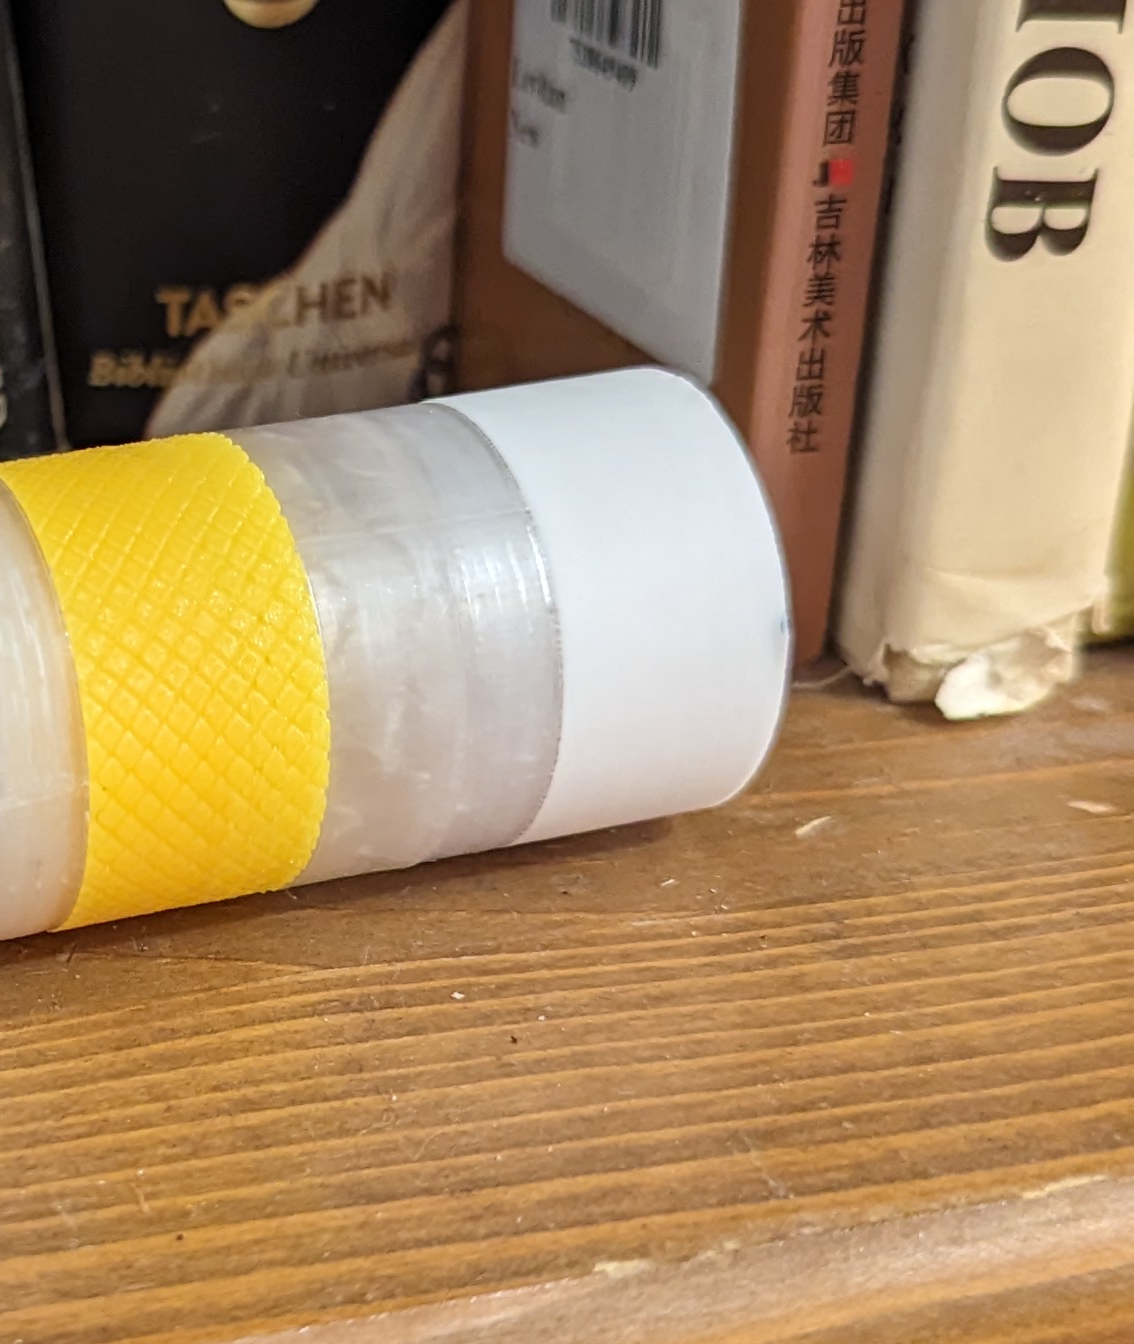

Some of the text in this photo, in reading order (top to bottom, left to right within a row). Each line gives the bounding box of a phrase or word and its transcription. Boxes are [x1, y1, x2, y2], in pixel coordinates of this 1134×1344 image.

[785, 194, 848, 455] 吉林美术出版社
